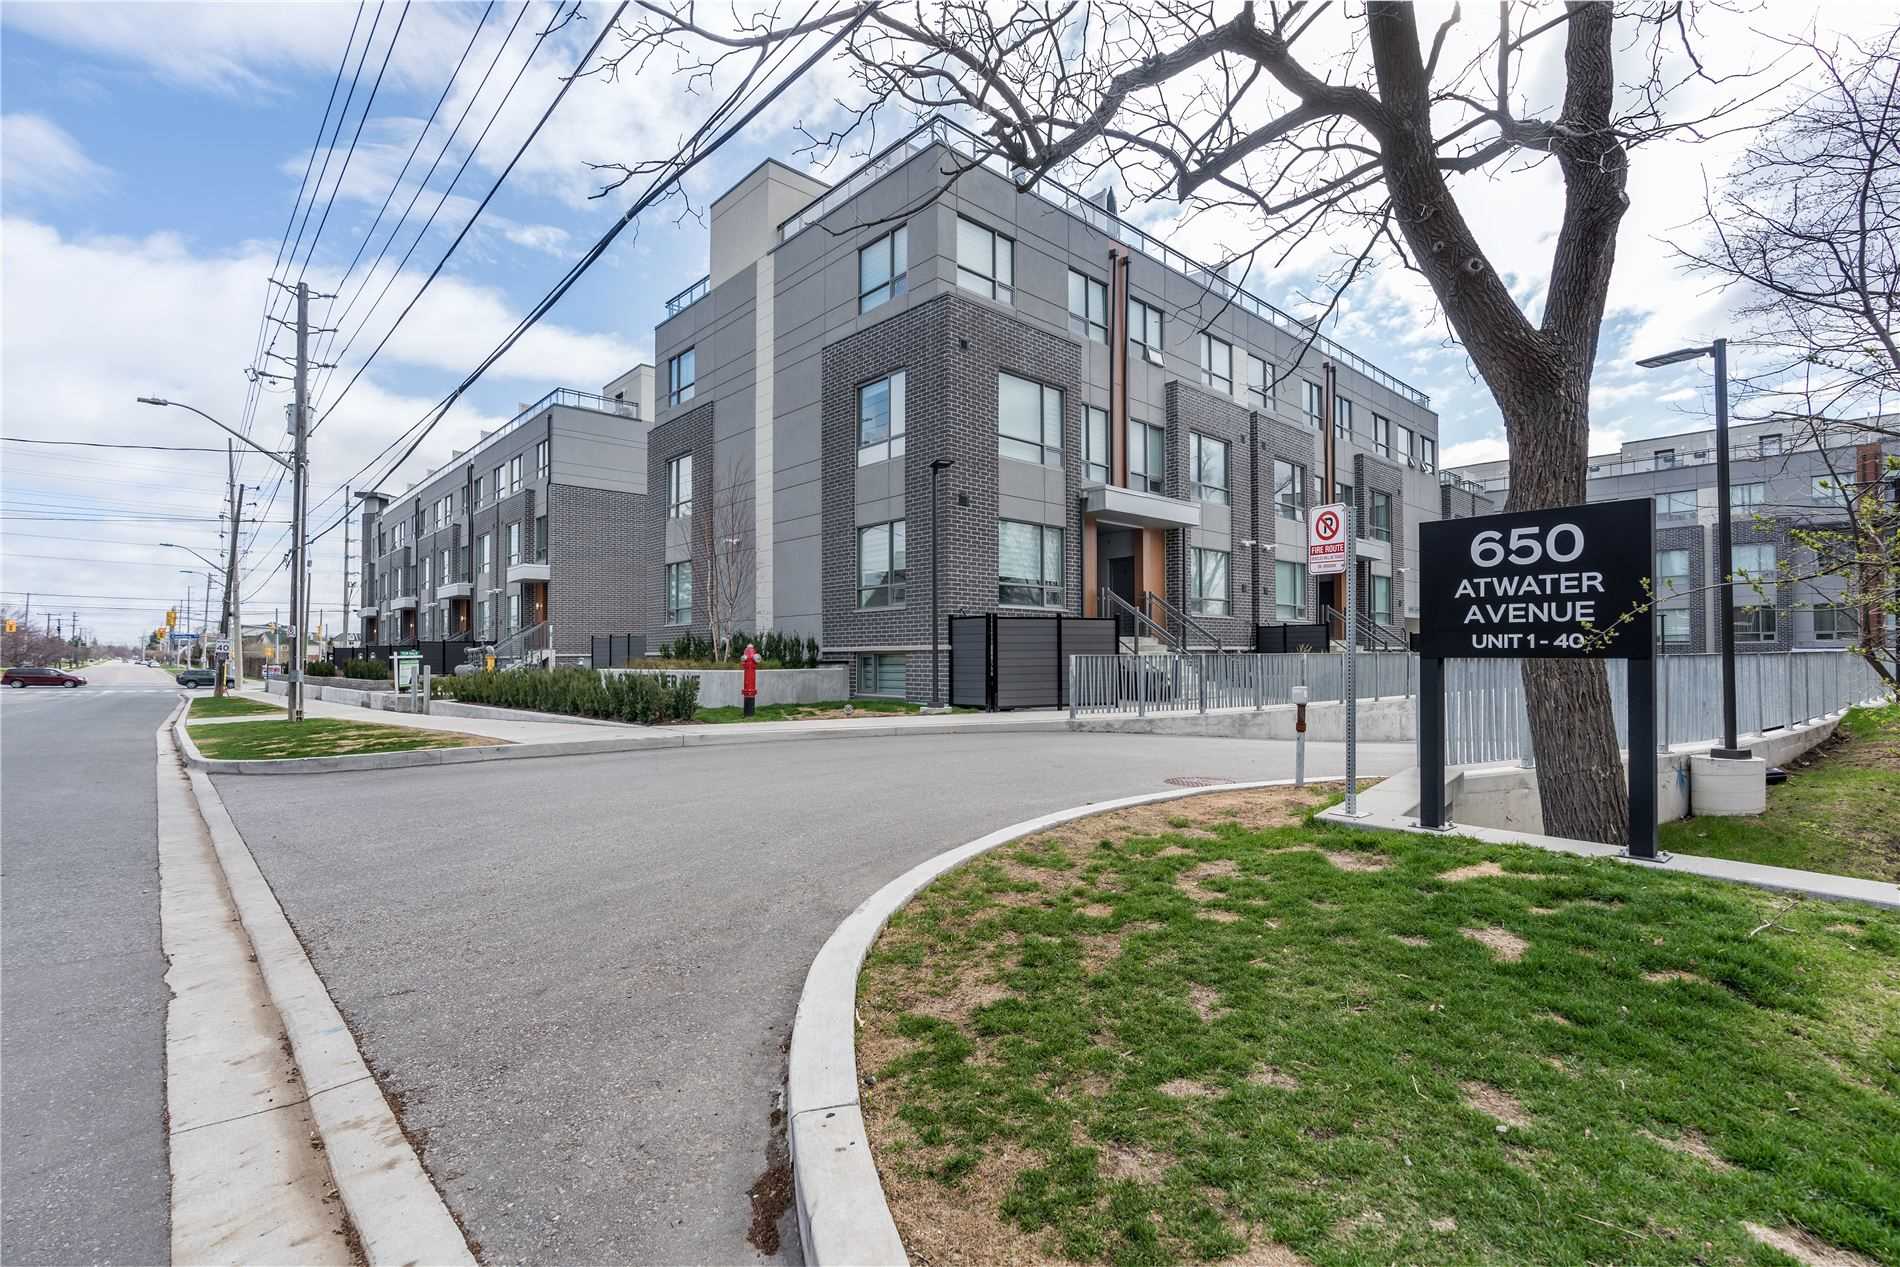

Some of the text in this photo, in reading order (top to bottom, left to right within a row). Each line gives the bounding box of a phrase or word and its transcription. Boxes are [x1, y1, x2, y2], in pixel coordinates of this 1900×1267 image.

[1311, 544, 1344, 555] FIRE ROUTE
[1470, 523, 1584, 567] 650
[1454, 571, 1605, 598] ATWATER
[1463, 600, 1595, 624] AVENUE
[1472, 633, 1523, 649] UNIT
[1526, 633, 1535, 649] 1
[1553, 633, 1585, 649] 40
